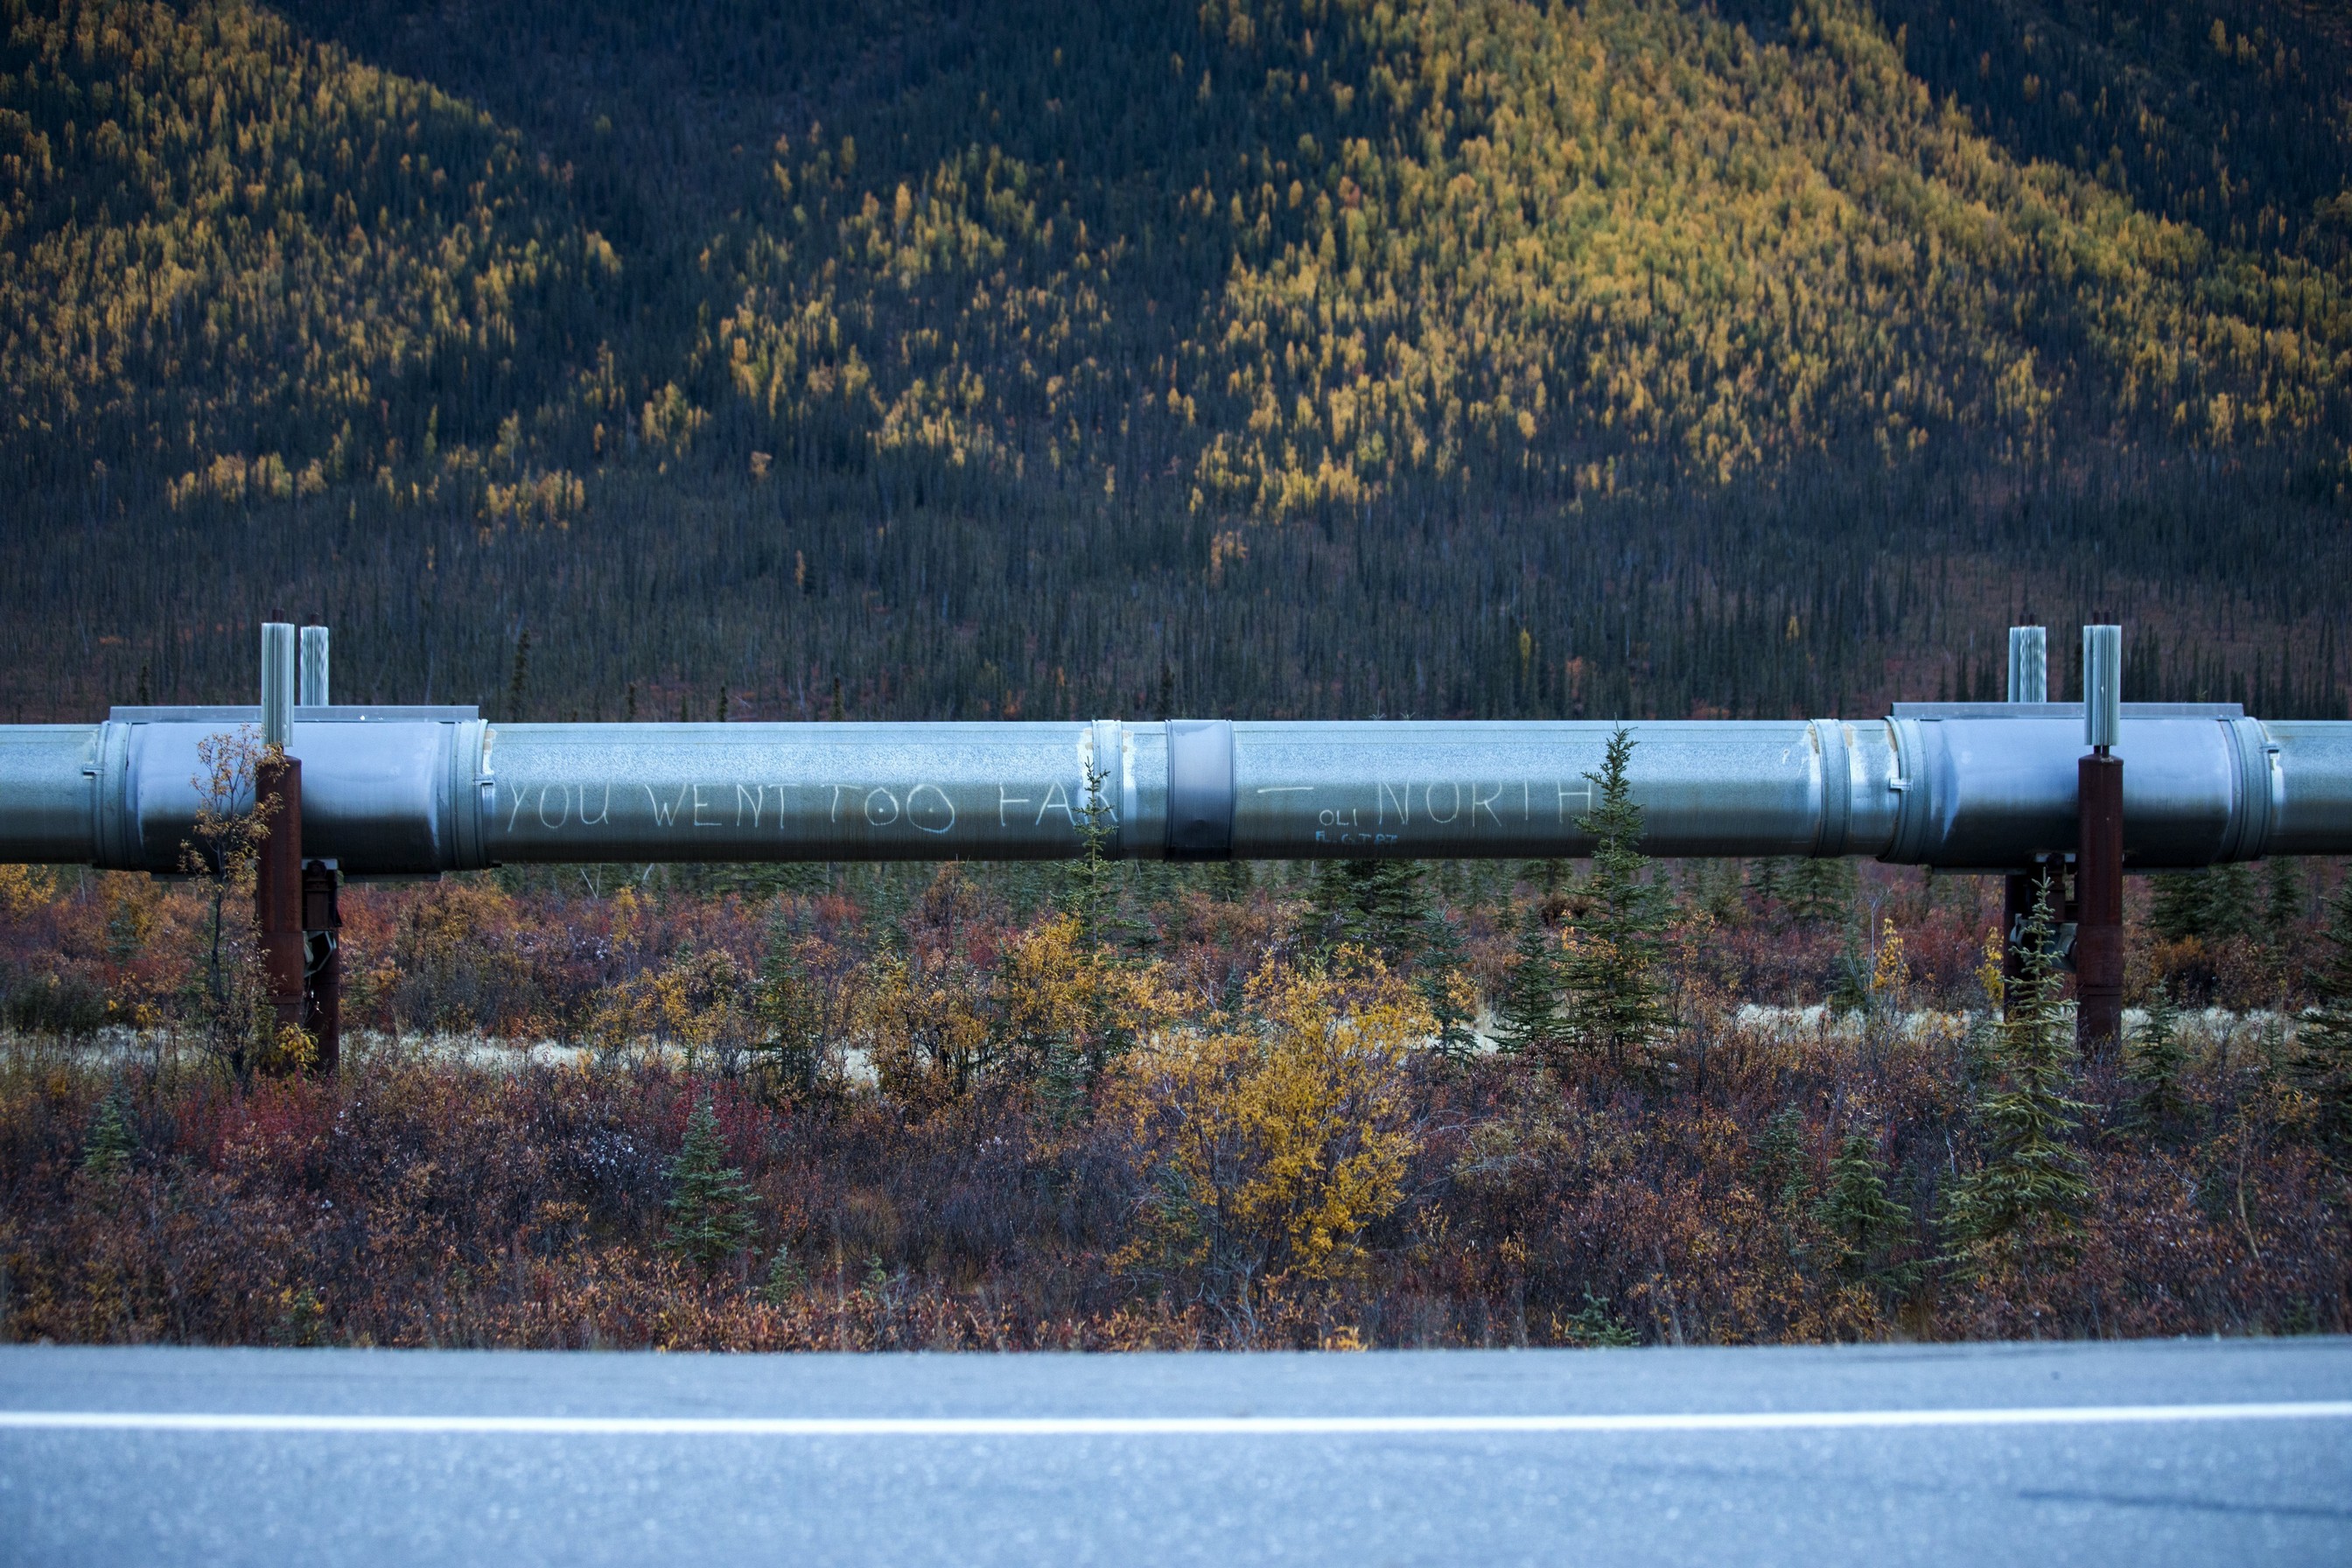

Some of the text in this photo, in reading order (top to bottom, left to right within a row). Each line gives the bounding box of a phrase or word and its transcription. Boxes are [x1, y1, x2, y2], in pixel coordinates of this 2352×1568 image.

[507, 778, 611, 832] YOU
[645, 782, 801, 830] WENT
[820, 783, 956, 834] TOO
[1377, 779, 1592, 828] NORTH
